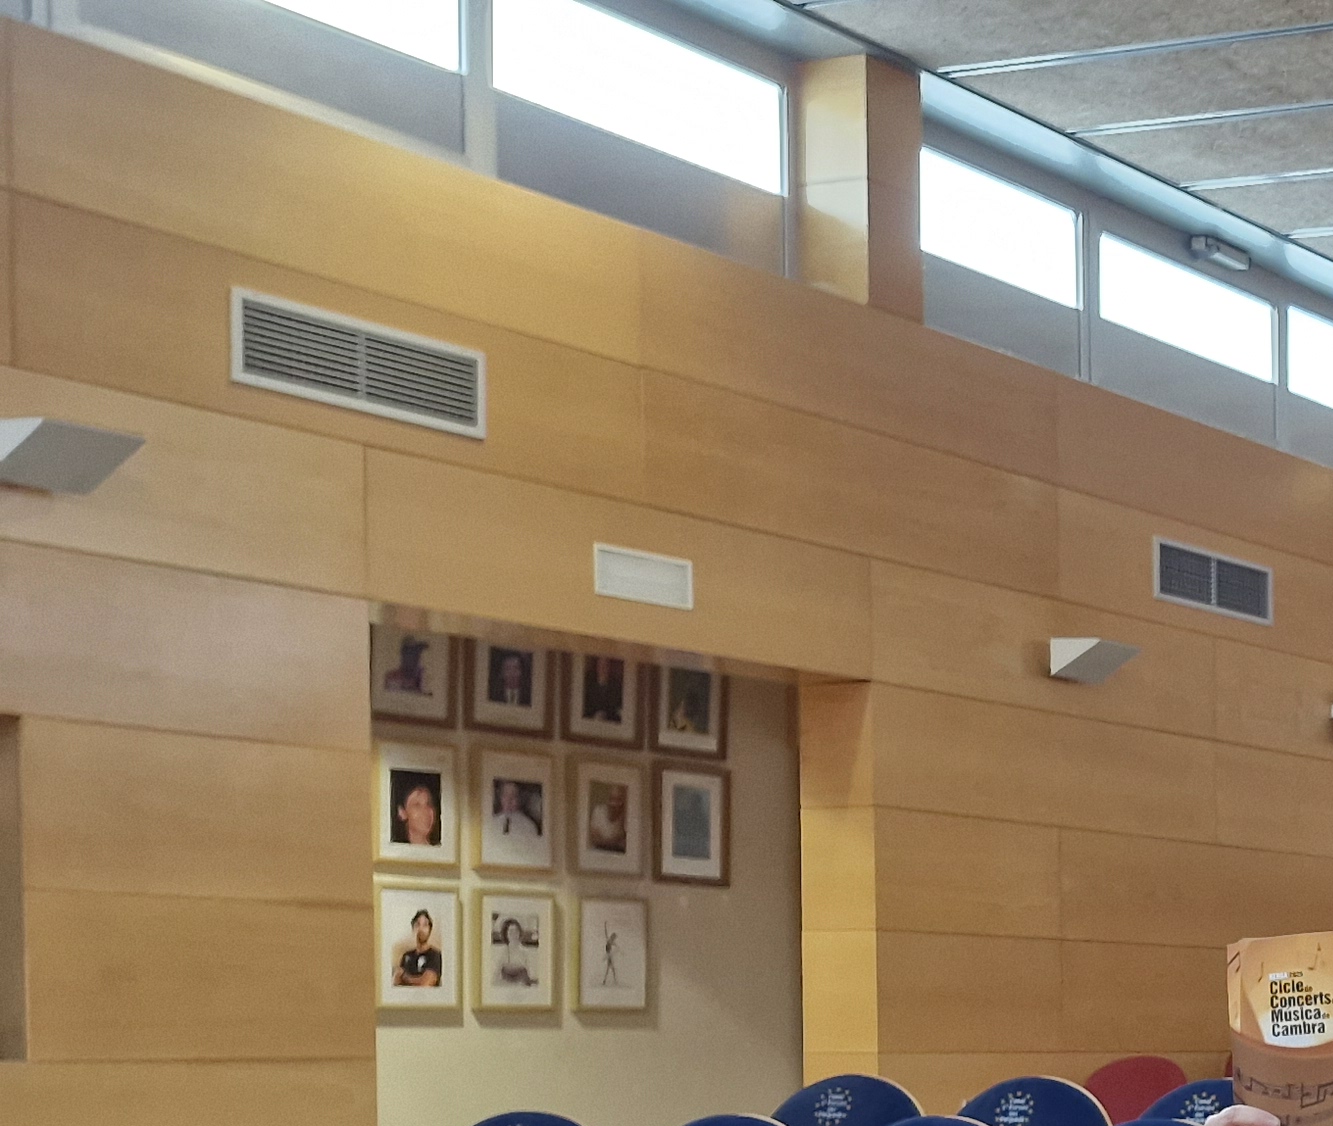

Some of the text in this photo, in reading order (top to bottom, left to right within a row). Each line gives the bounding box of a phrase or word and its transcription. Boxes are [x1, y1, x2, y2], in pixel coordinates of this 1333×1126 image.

[1270, 980, 1304, 995] Cicle
[1270, 992, 1331, 1009] Concerts
[1271, 1005, 1321, 1023] Música
[1272, 1022, 1325, 1037] Cambra
